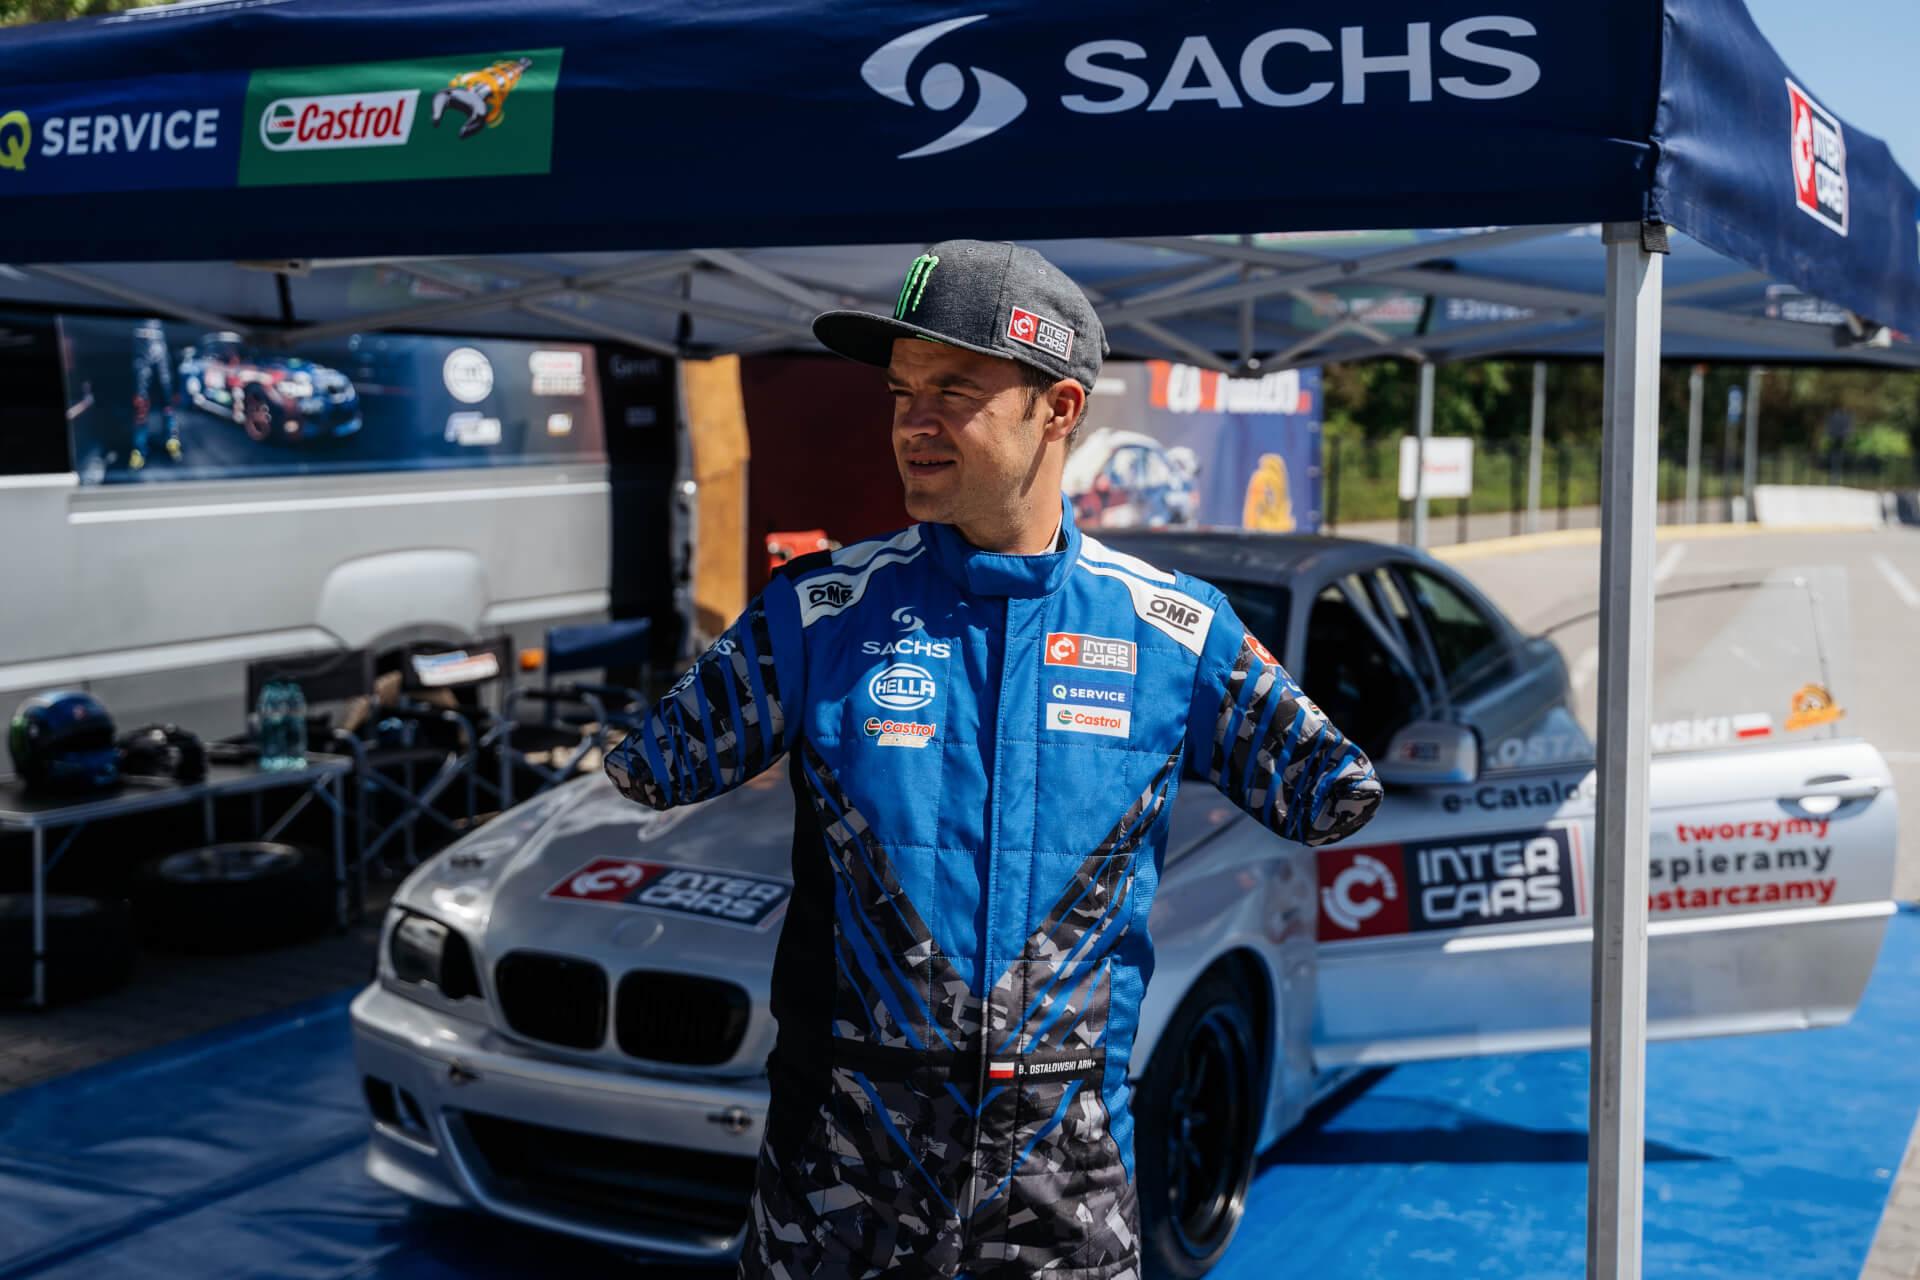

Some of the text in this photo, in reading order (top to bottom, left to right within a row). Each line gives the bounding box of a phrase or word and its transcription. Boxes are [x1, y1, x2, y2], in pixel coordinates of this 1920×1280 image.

[1060, 15, 1541, 115] SACHS
[298, 98, 406, 142] Castrol
[40, 109, 220, 156] SERVICE
[1037, 333, 1066, 352] CARS
[1040, 322, 1068, 343] INTER
[809, 585, 854, 604] OMP
[1151, 600, 1198, 627] OMP
[861, 639, 951, 658] SACHS
[1083, 639, 1129, 656] INTER
[1082, 653, 1129, 668] CARS
[875, 679, 936, 698] HELLA
[1069, 688, 1126, 702] SERVICE
[882, 719, 937, 736] Castrol
[1074, 712, 1121, 729] Castrol
[1676, 816, 1831, 843] tworzymy
[1417, 837, 1559, 884] INTER
[1650, 847, 1832, 884] spieramy
[660, 871, 782, 902] INTER
[640, 886, 760, 918] CARS
[1422, 875, 1563, 922] CARS
[1018, 1064, 1027, 1075] B.
